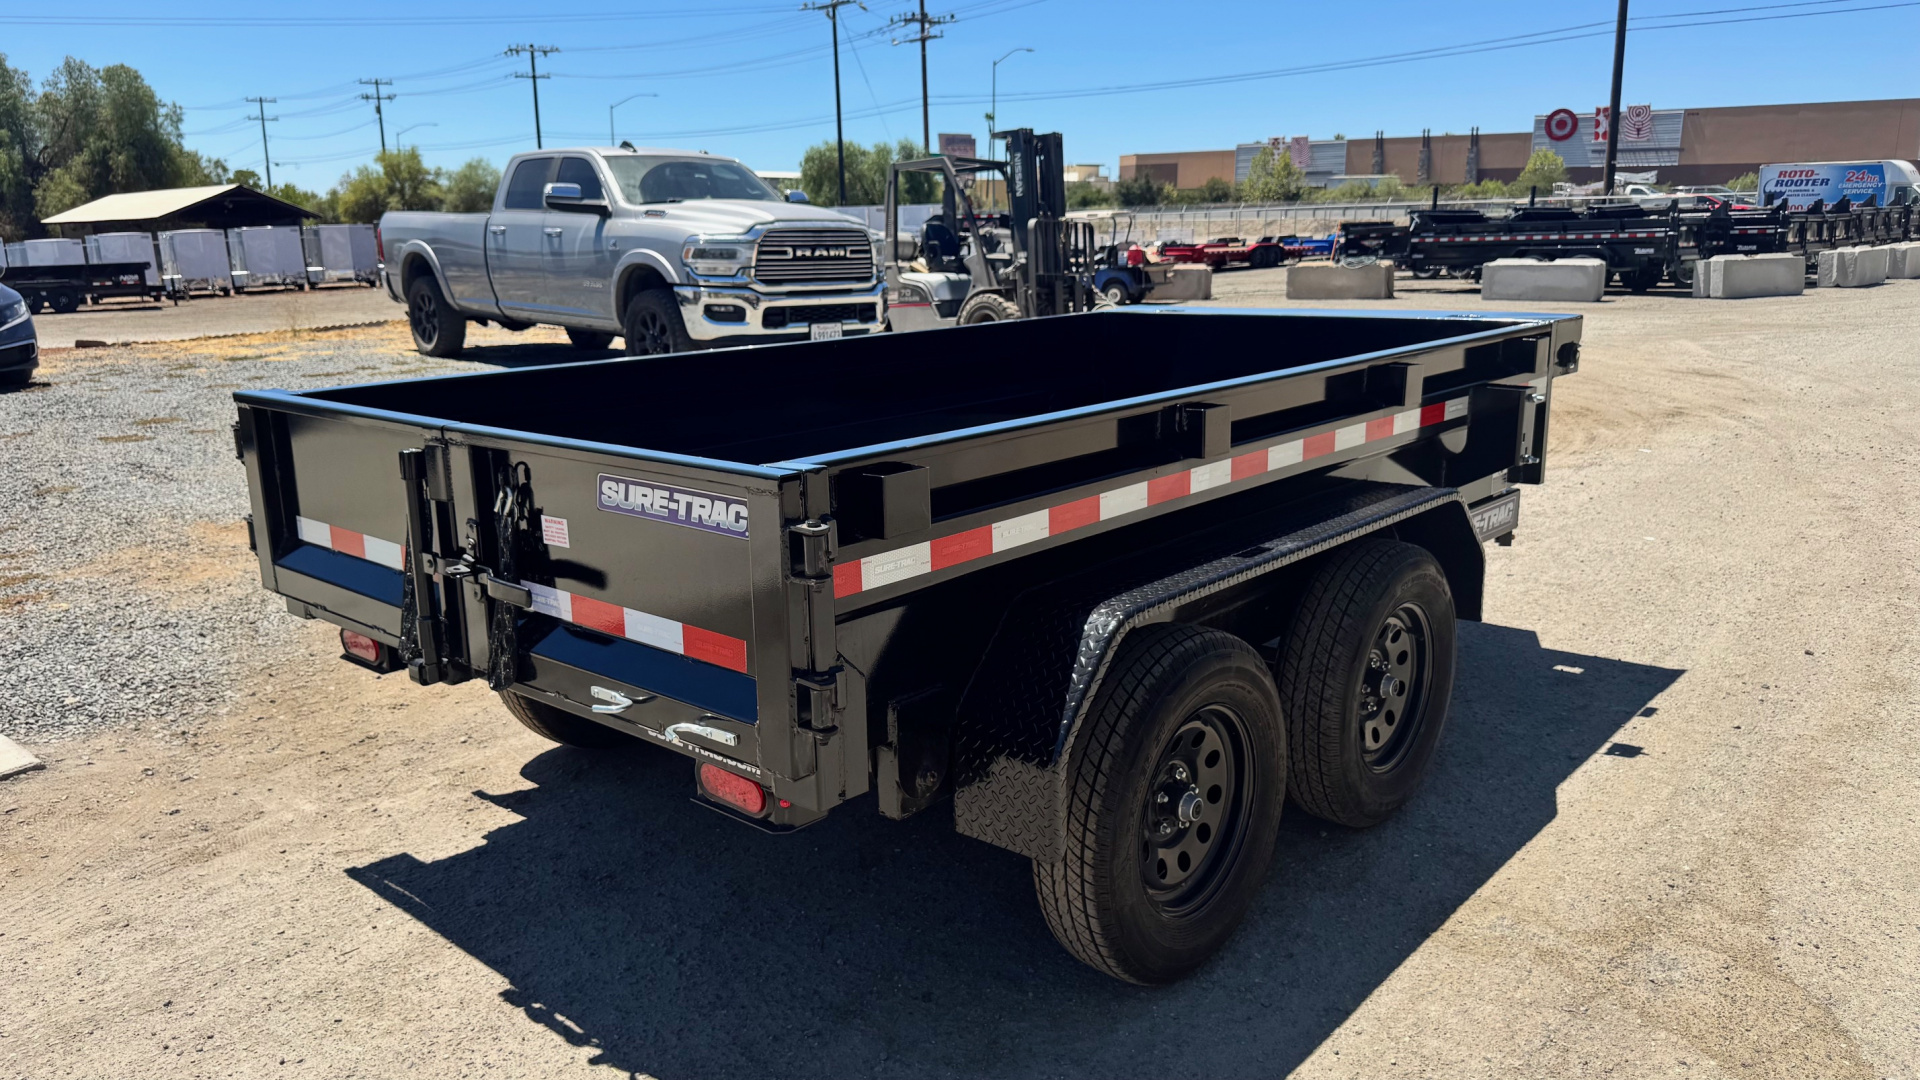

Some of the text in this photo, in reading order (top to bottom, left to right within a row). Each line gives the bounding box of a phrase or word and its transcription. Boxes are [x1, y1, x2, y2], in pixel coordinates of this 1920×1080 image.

[1014, 153, 1023, 197] NISSAN
[1778, 169, 1820, 179] ROTO-
[1774, 178, 1831, 187] ROOTER
[795, 246, 846, 257] RAM
[601, 480, 748, 532] SURE-TRAC
